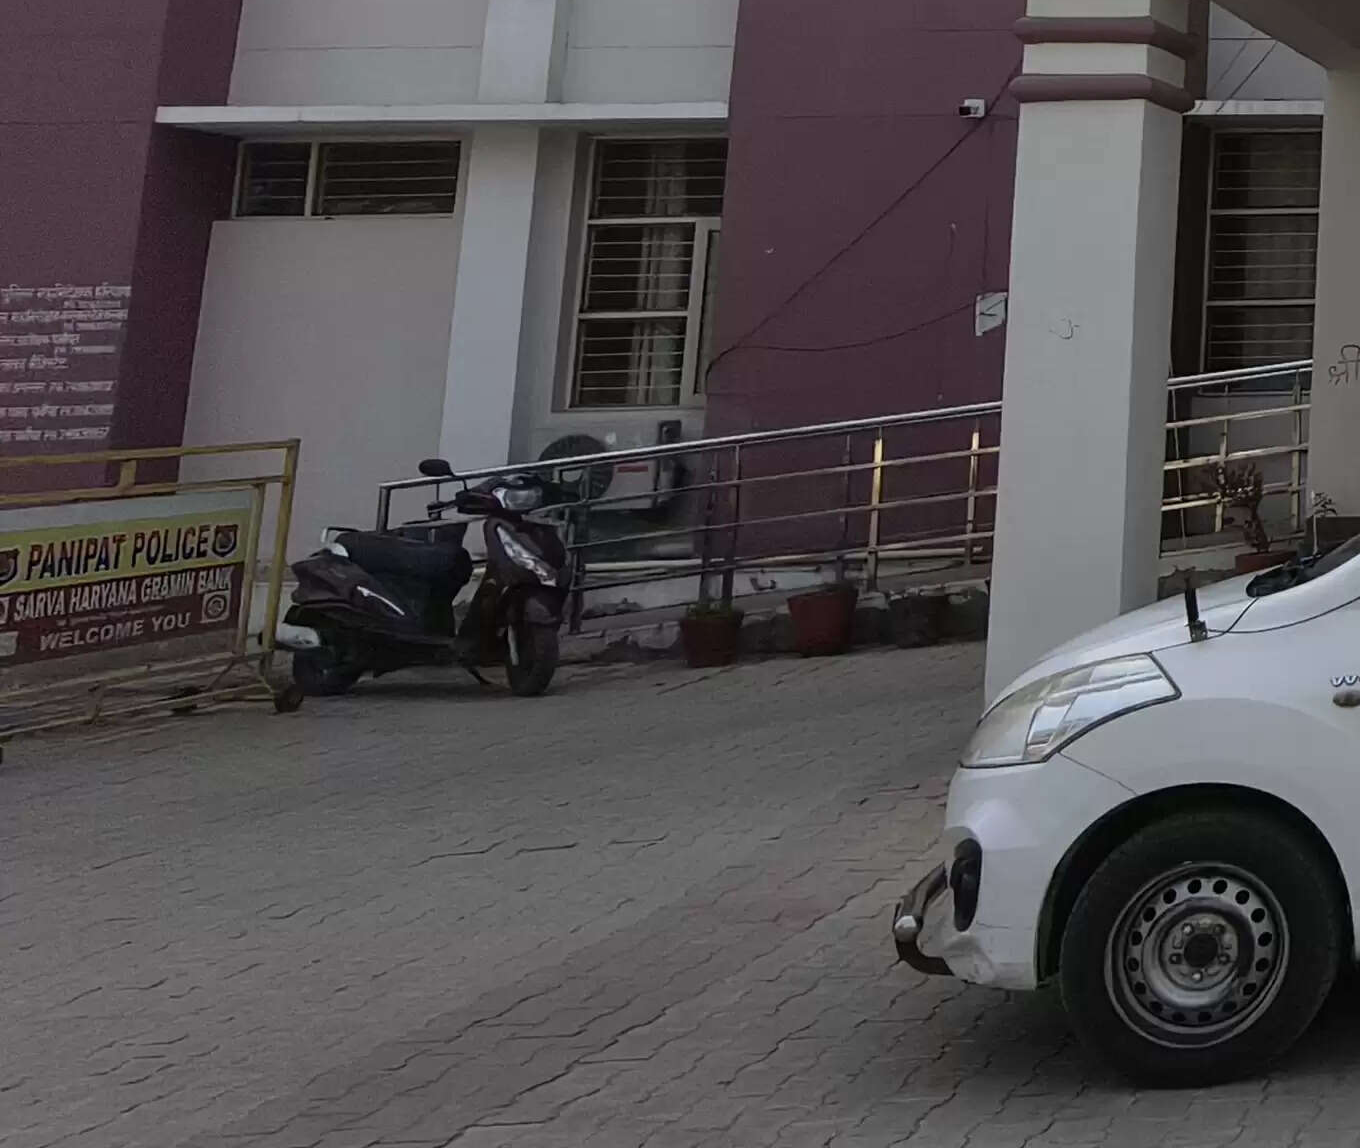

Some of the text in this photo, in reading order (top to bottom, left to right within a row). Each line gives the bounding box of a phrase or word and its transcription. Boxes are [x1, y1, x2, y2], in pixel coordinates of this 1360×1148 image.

[26, 523, 211, 581] PANIPAT POLICE
[13, 589, 66, 622] SARVA
[69, 578, 137, 613] HARYANA
[141, 570, 194, 601] GRAMIN
[197, 564, 233, 592] BANK
[40, 618, 145, 651] WELCOME
[152, 611, 192, 633] YOU
